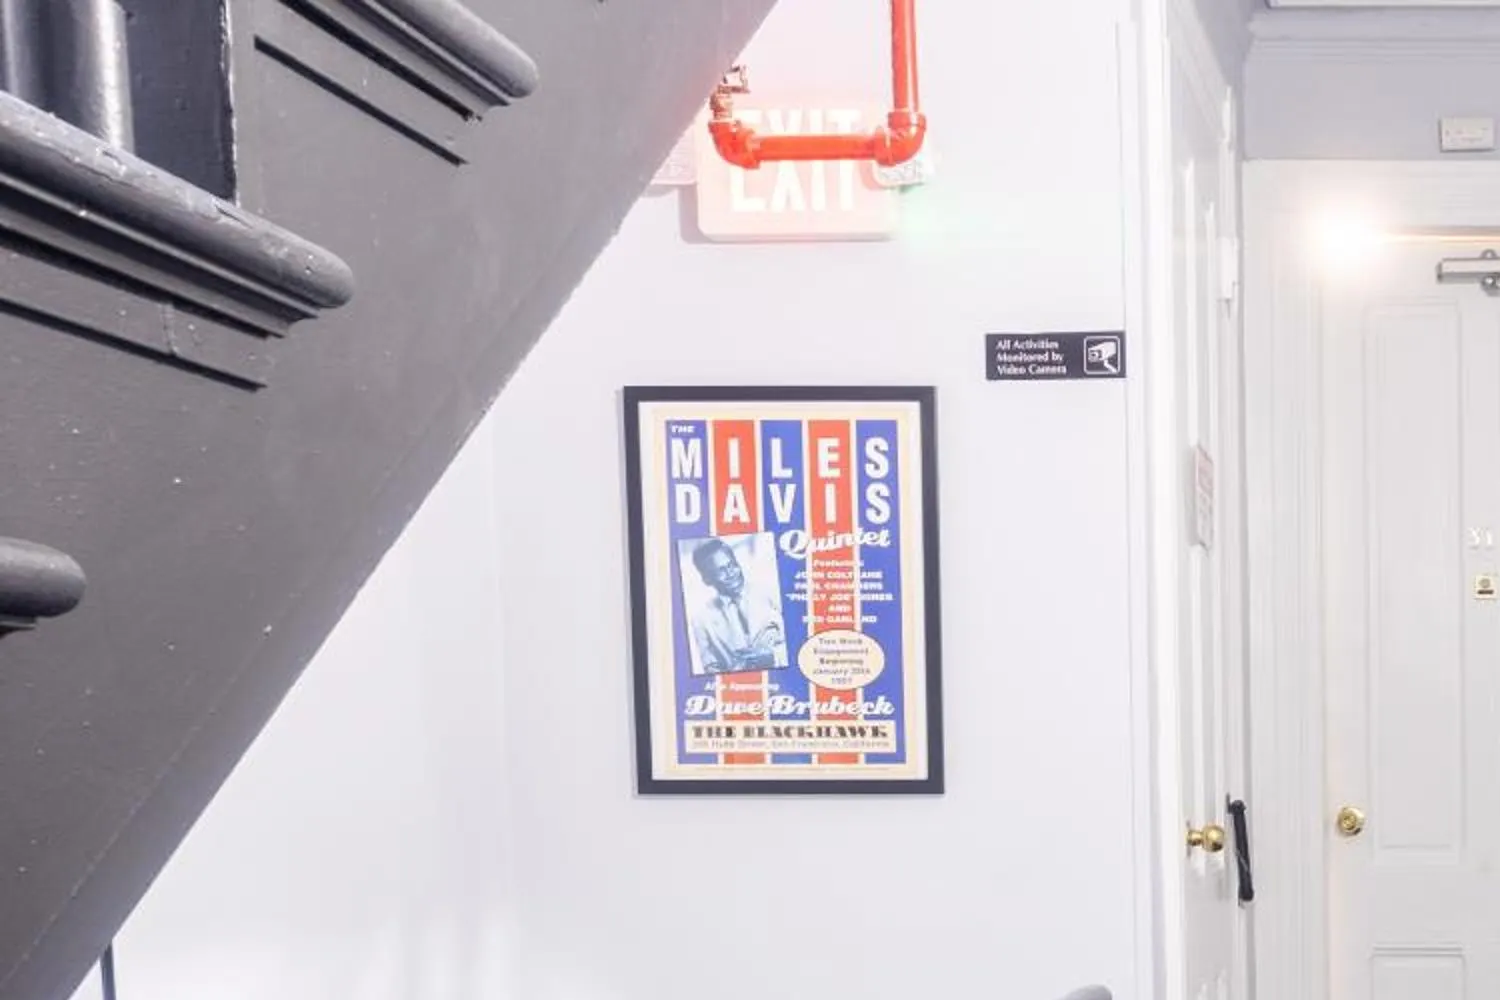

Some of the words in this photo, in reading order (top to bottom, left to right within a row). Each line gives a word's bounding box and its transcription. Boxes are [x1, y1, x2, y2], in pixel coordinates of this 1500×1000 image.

[730, 108, 863, 213] EXIT
[995, 338, 1011, 350] All
[1012, 338, 1059, 350] Activities
[996, 351, 1049, 362] Monitored
[1051, 351, 1065, 364] by
[996, 363, 1027, 376] Video
[1028, 363, 1067, 375] Camera
[671, 425, 695, 433] THE
[671, 437, 889, 479] MILES
[674, 482, 891, 525] DAVIS
[779, 527, 892, 560] Quintet
[794, 571, 825, 579] JON
[827, 571, 883, 579] COLTANE
[794, 582, 822, 590] PAL
[824, 582, 883, 590] CHAMERS
[827, 604, 853, 612] AND
[802, 615, 825, 623] RD
[827, 615, 877, 623] GARLND
[704, 681, 727, 690] Alo
[684, 695, 766, 715] Dave
[767, 695, 895, 715] Brubeck
[691, 725, 736, 738] THE
[743, 725, 888, 738] BLACKHAWK
